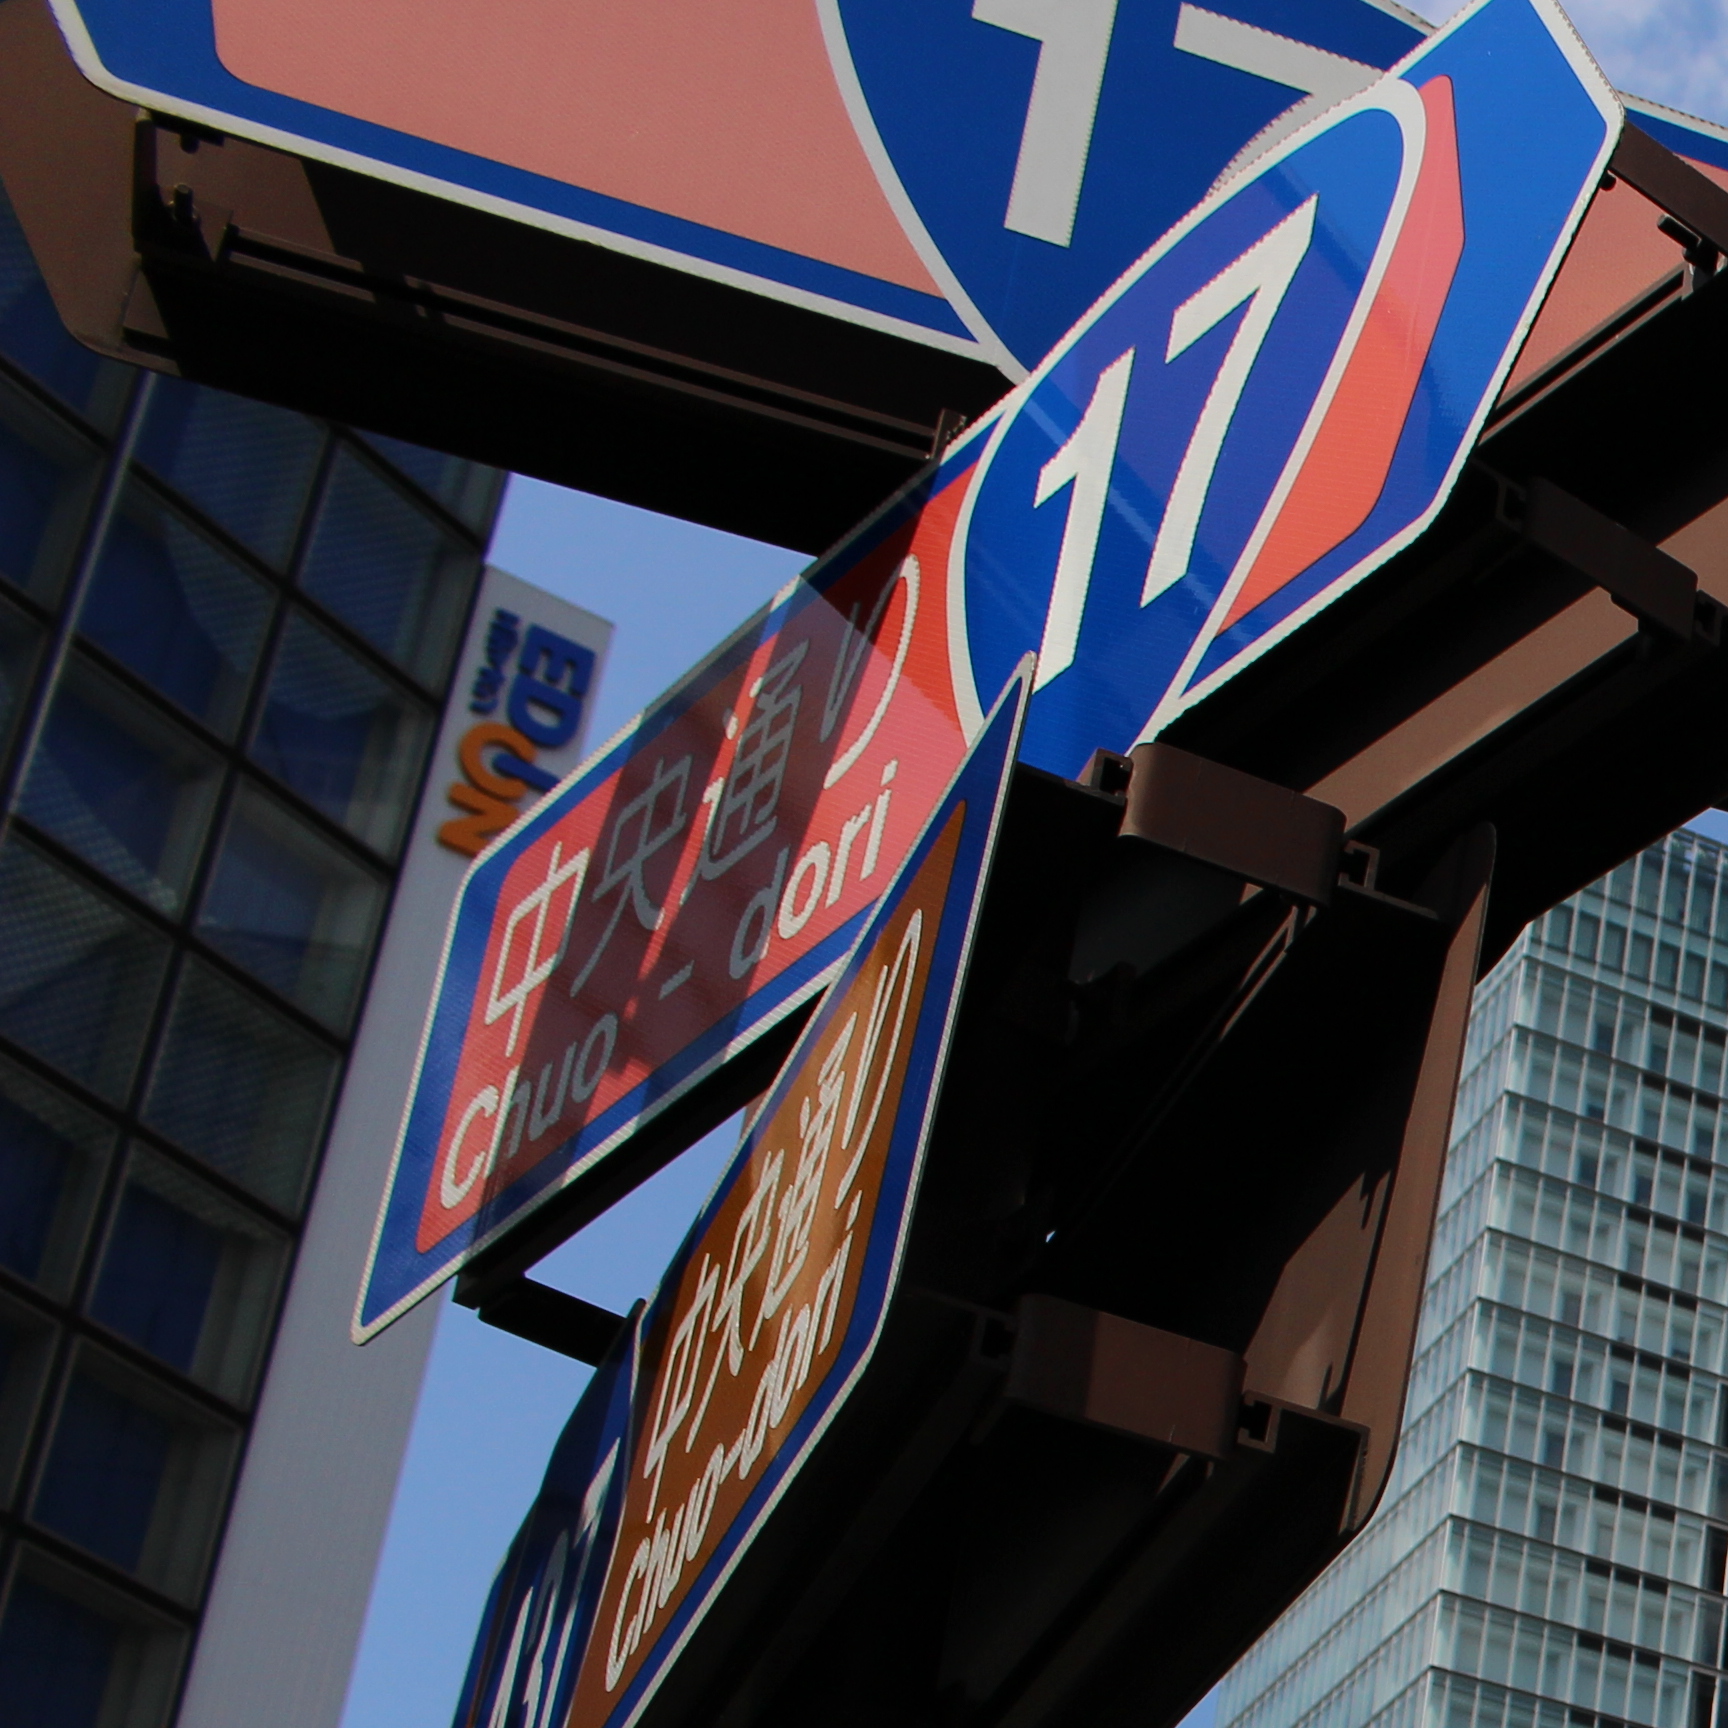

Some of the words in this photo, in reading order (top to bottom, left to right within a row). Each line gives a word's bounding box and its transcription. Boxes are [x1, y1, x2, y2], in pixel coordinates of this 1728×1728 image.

[1034, 193, 1318, 692] 17
[486, 557, 920, 1058] 中央通り
[605, 1188, 860, 1692] Chuo-dori
[643, 907, 922, 1520] 中央通り
